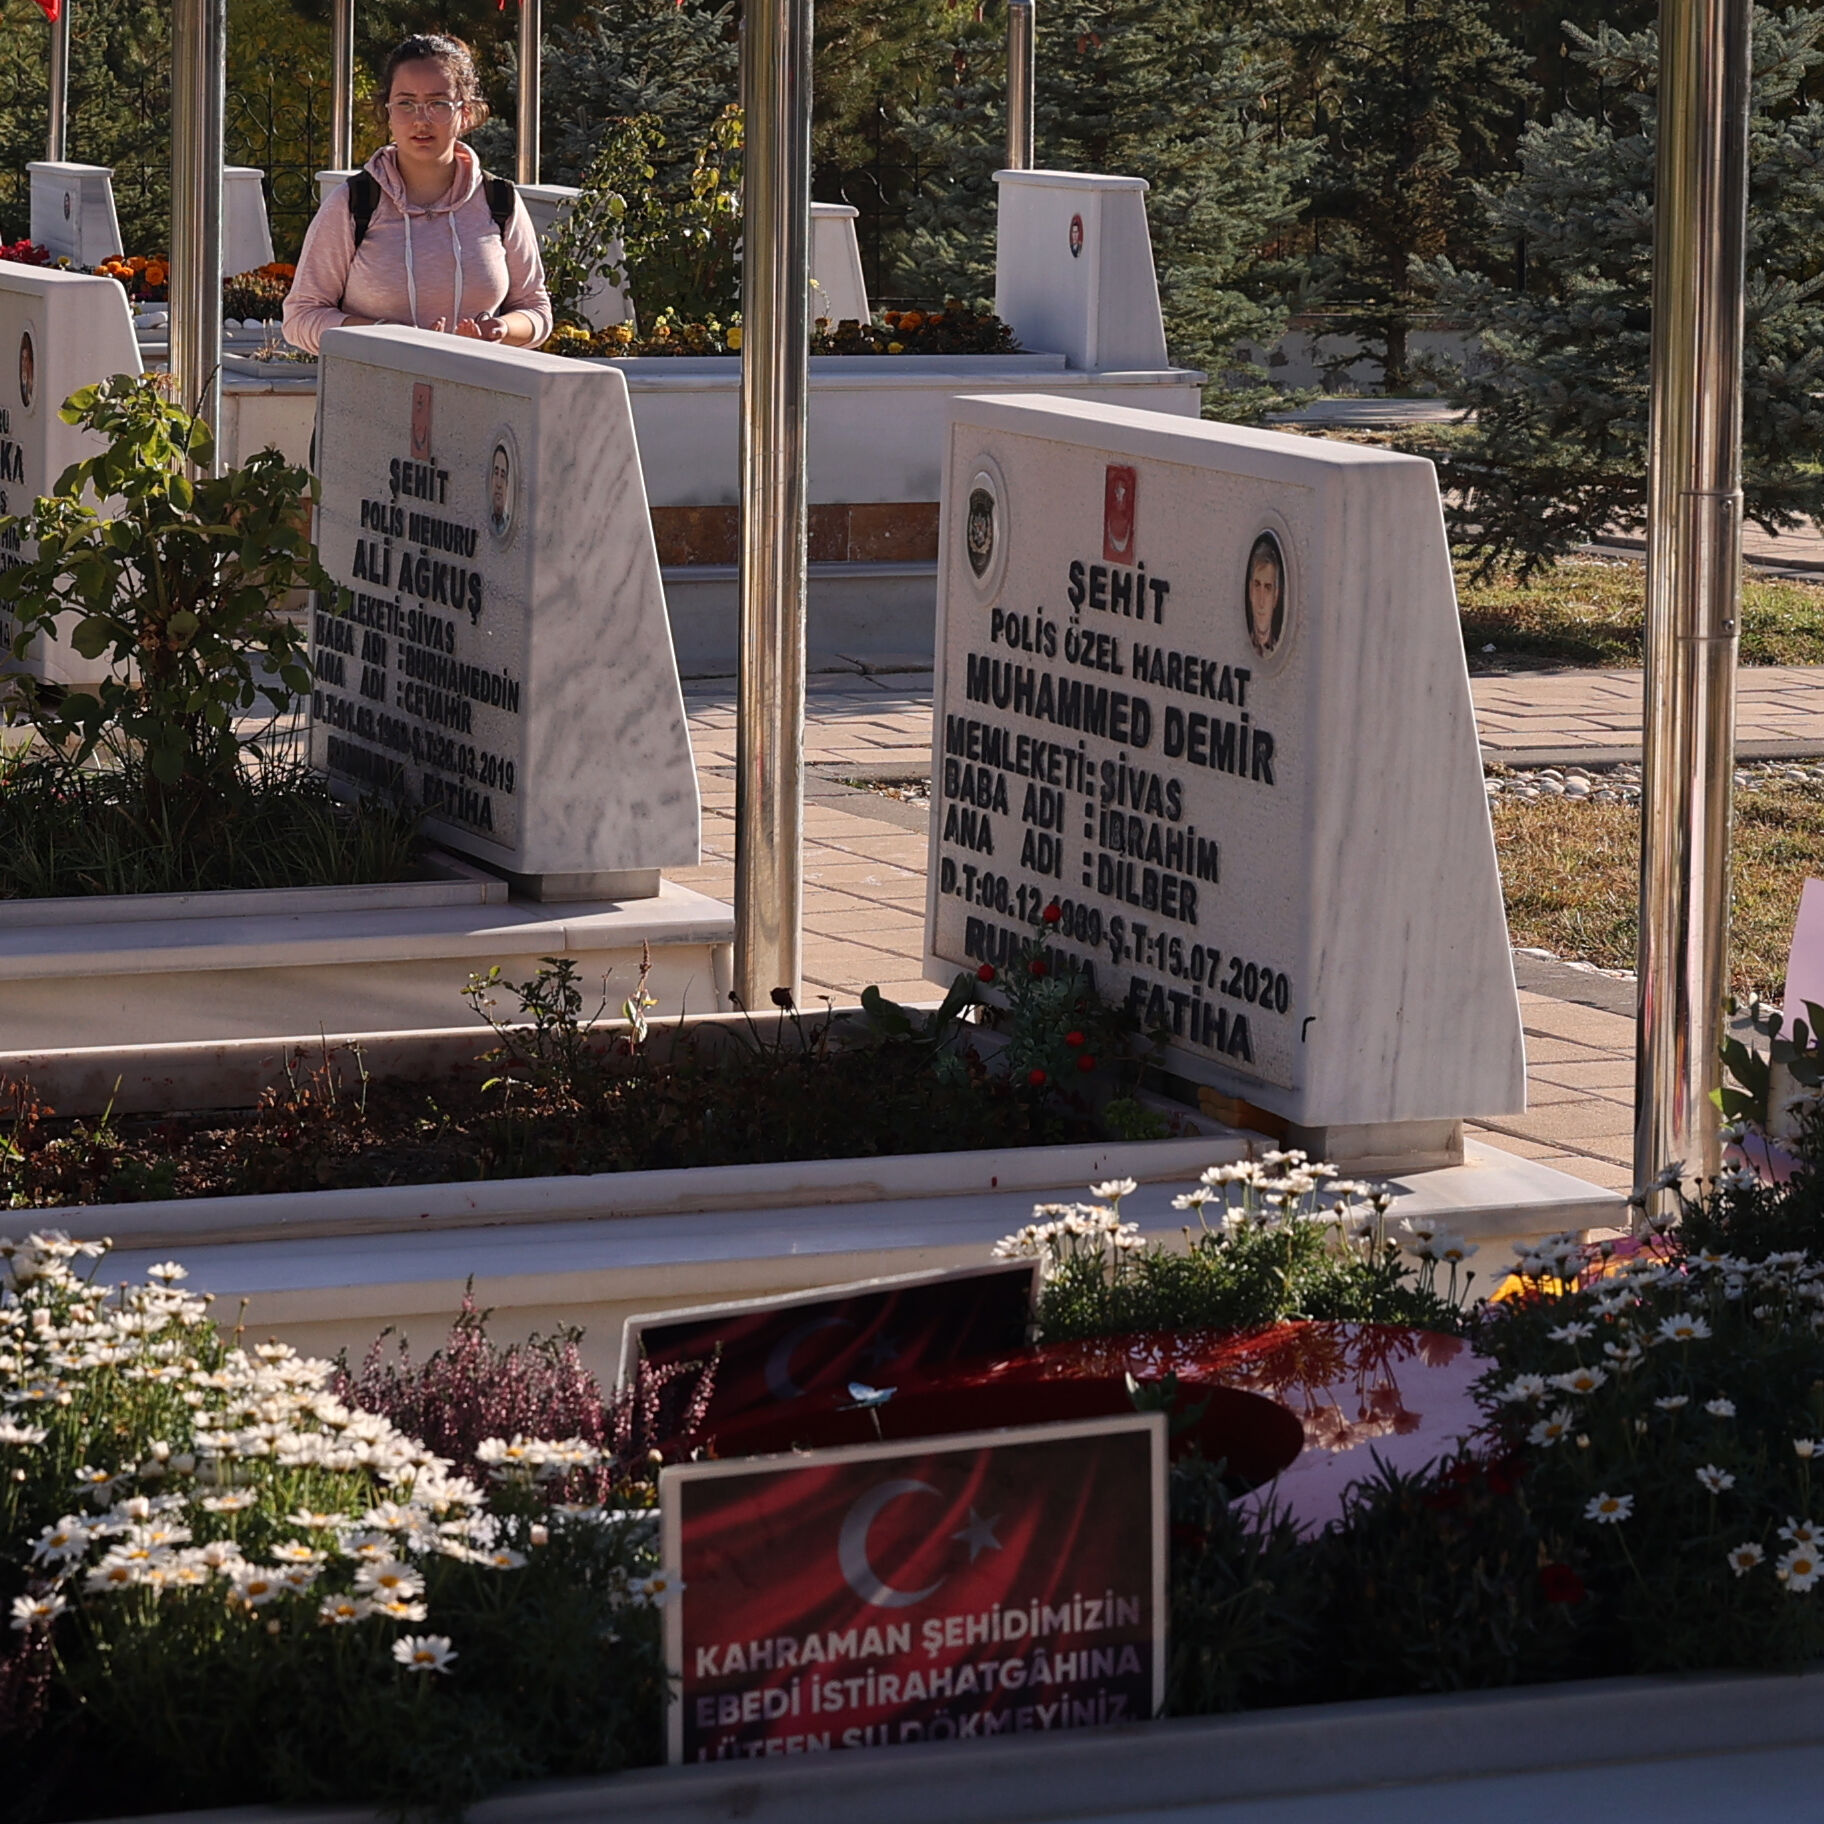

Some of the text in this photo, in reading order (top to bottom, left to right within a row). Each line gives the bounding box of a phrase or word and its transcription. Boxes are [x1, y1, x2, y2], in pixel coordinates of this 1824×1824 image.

[389, 457, 448, 503] ŞEHİT
[361, 499, 476, 557] POLİS MEMURU
[353, 537, 481, 625] ALİ AĞKUŞ
[1068, 559, 1170, 625] ŞEHİT
[316, 614, 354, 656] BABA
[361, 630, 387, 668] ADI
[991, 607, 1251, 707] POLİS ÖZEL HAREKAT
[360, 665, 386, 702] ADI
[966, 652, 1274, 785] MUHAMMED DEMİR
[423, 773, 493, 832] FATİHA
[945, 757, 1008, 816] BABA
[1022, 782, 1064, 833] ADI
[944, 803, 993, 856] ANA
[1021, 829, 1063, 879] ADI
[1129, 975, 1254, 1064] FATİHA
[695, 1589, 1141, 1678] KAHRAMAN ŞEHİDİMİZİN
[695, 1644, 1143, 1728] EBEDİ İSTİRAHATGÂHINA
